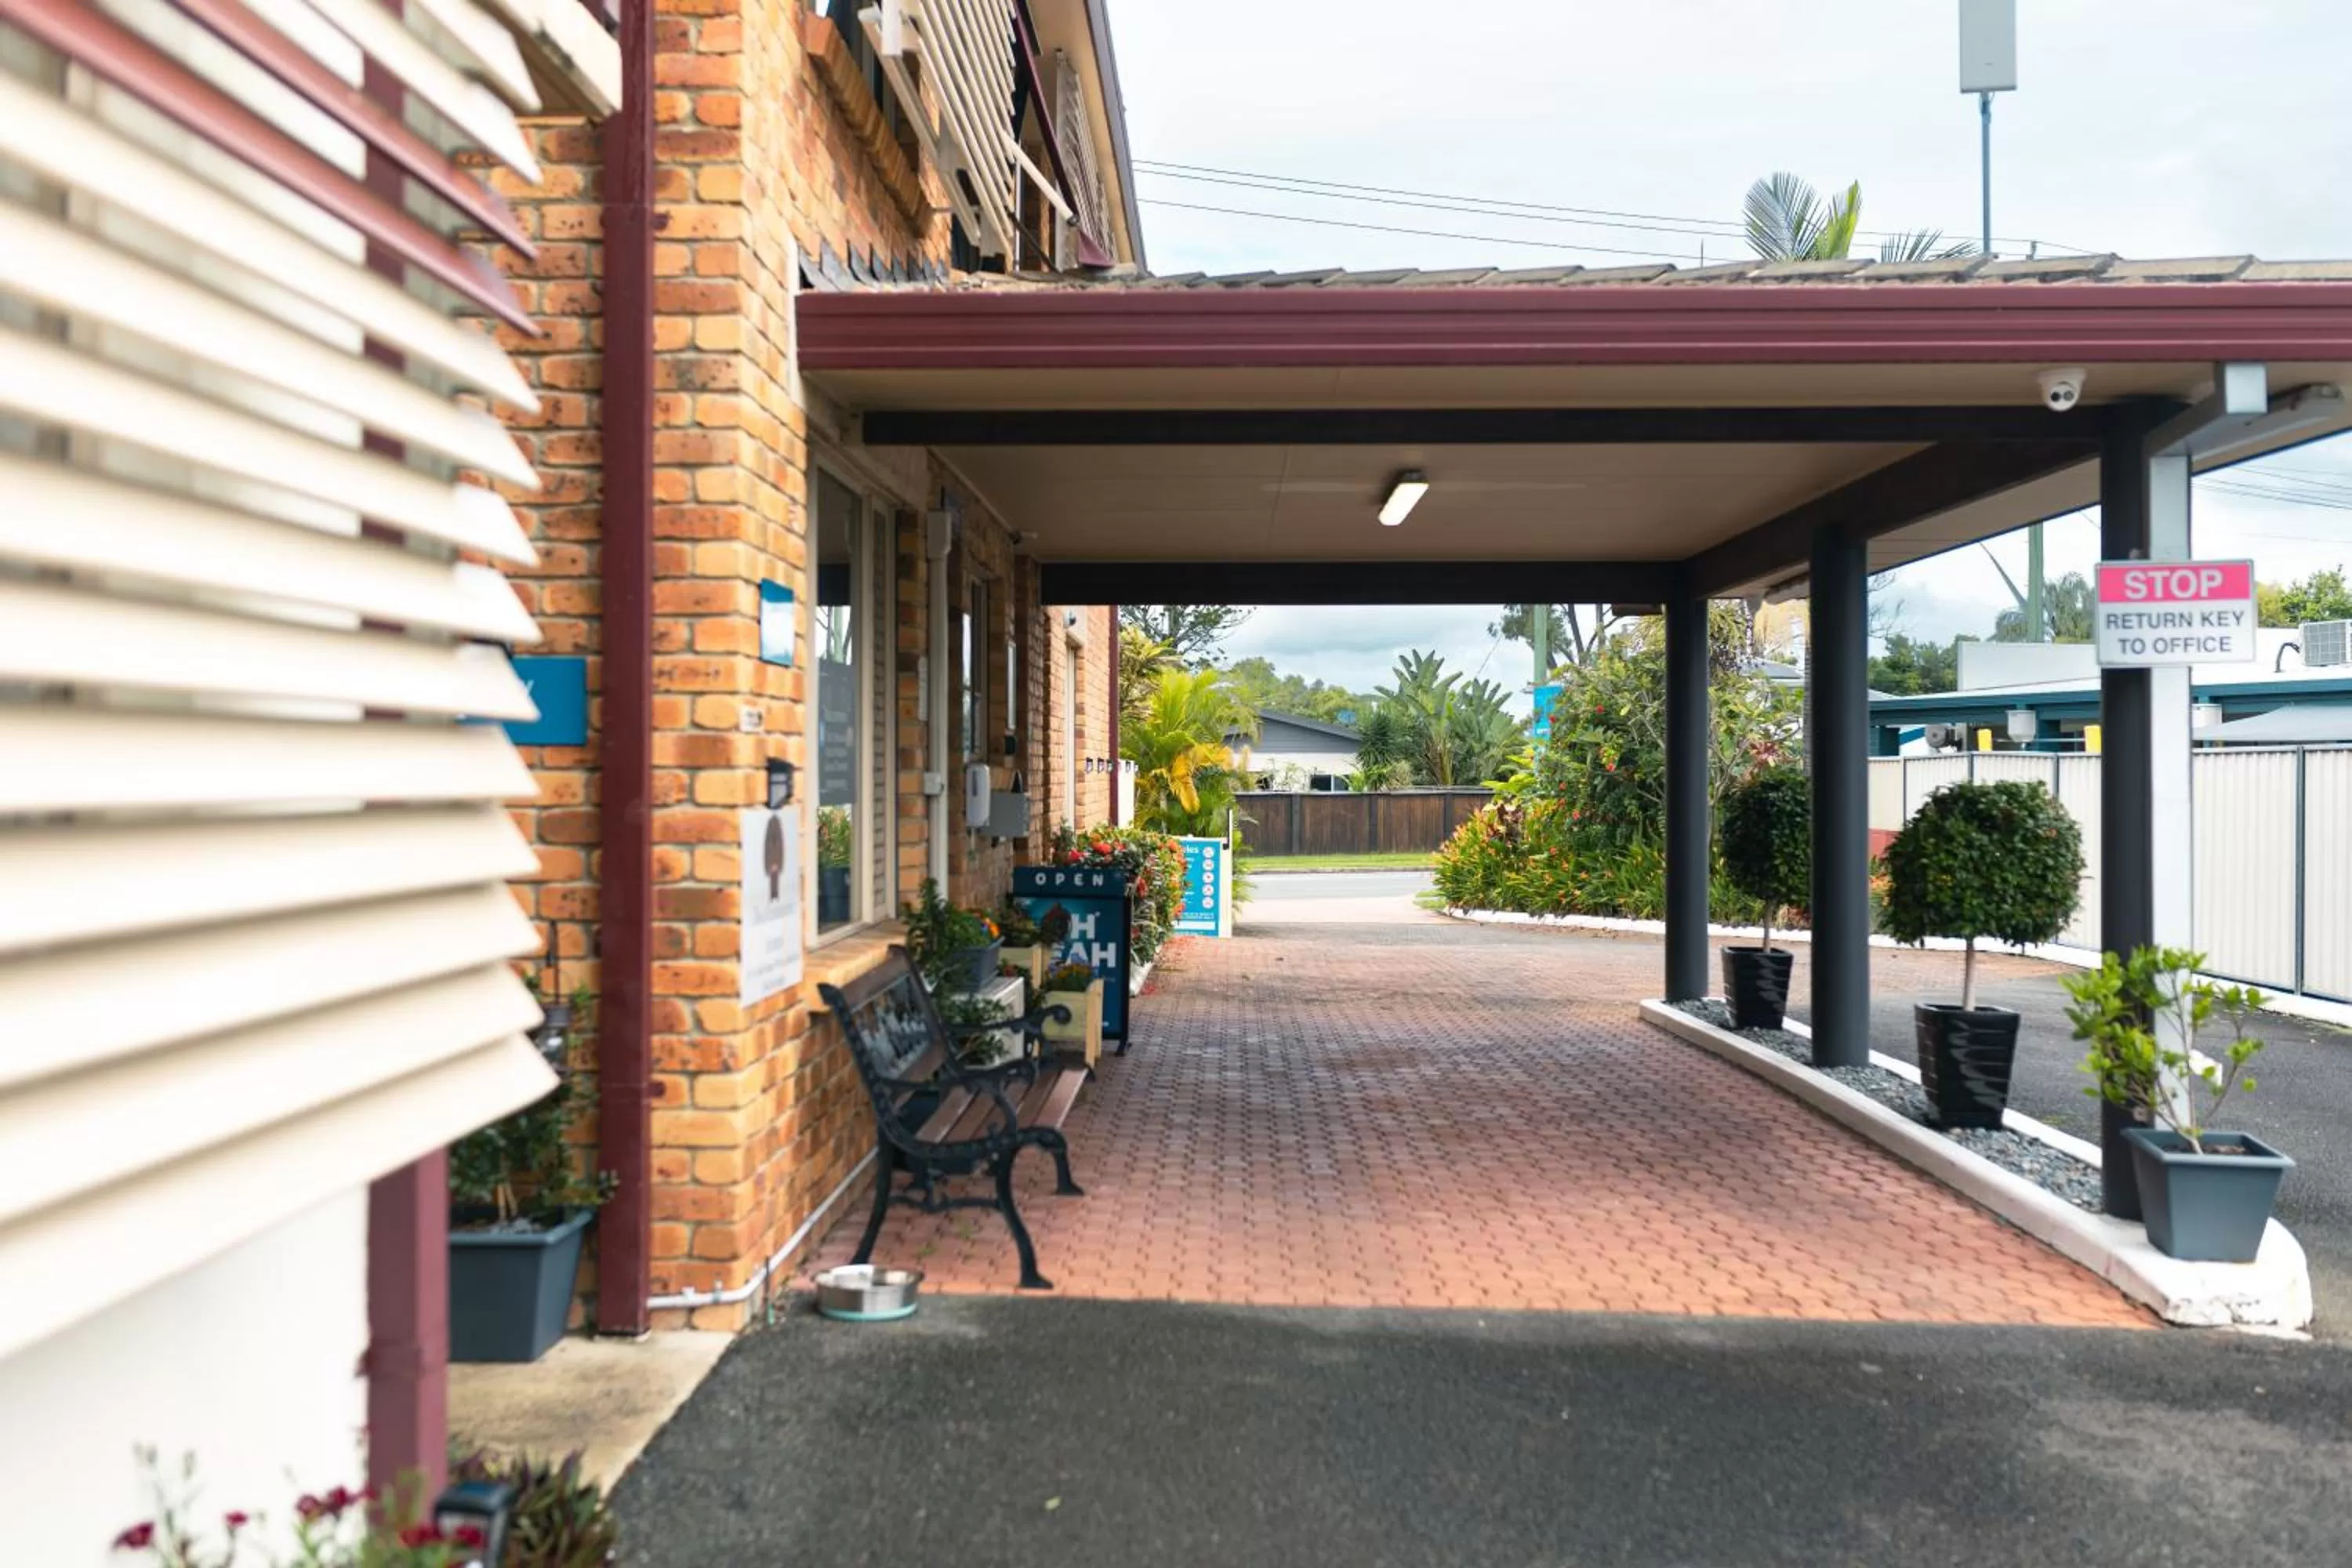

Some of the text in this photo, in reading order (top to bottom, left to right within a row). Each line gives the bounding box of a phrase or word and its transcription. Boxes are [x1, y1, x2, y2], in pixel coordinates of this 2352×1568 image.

[2125, 568, 2223, 599] STOP
[2107, 610, 2245, 630] RETURN KEY
[2118, 636, 2231, 655] TO OFFICE
[1035, 872, 1104, 886] OPEN
[1068, 913, 1095, 940] H
[1051, 942, 1116, 968] EAH
